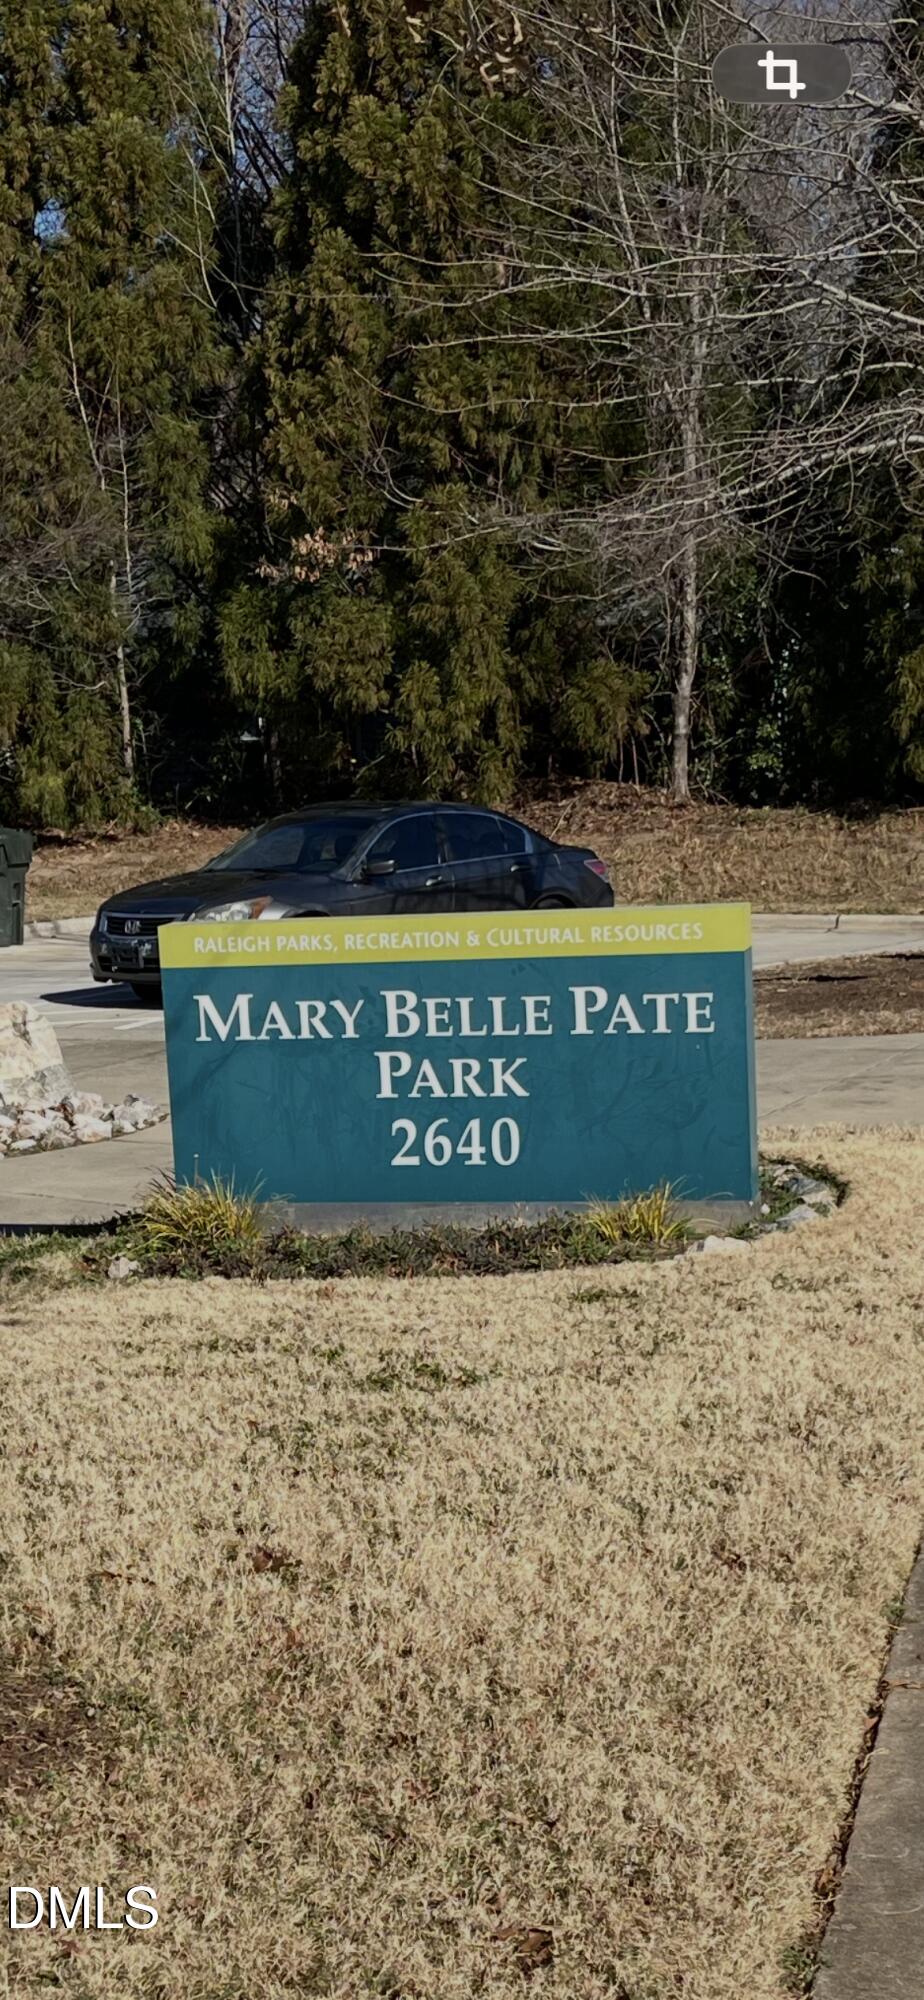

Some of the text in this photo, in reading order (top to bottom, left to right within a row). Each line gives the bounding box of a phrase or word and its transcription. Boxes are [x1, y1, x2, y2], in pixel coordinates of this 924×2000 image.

[194, 922, 703, 953] RALEIGH PARKS, RECREATION & CULTURAL RESOURCES
[193, 985, 716, 1042] MARY BELLE PATE
[373, 1050, 530, 1099] PARK
[390, 1116, 520, 1167] 2640
